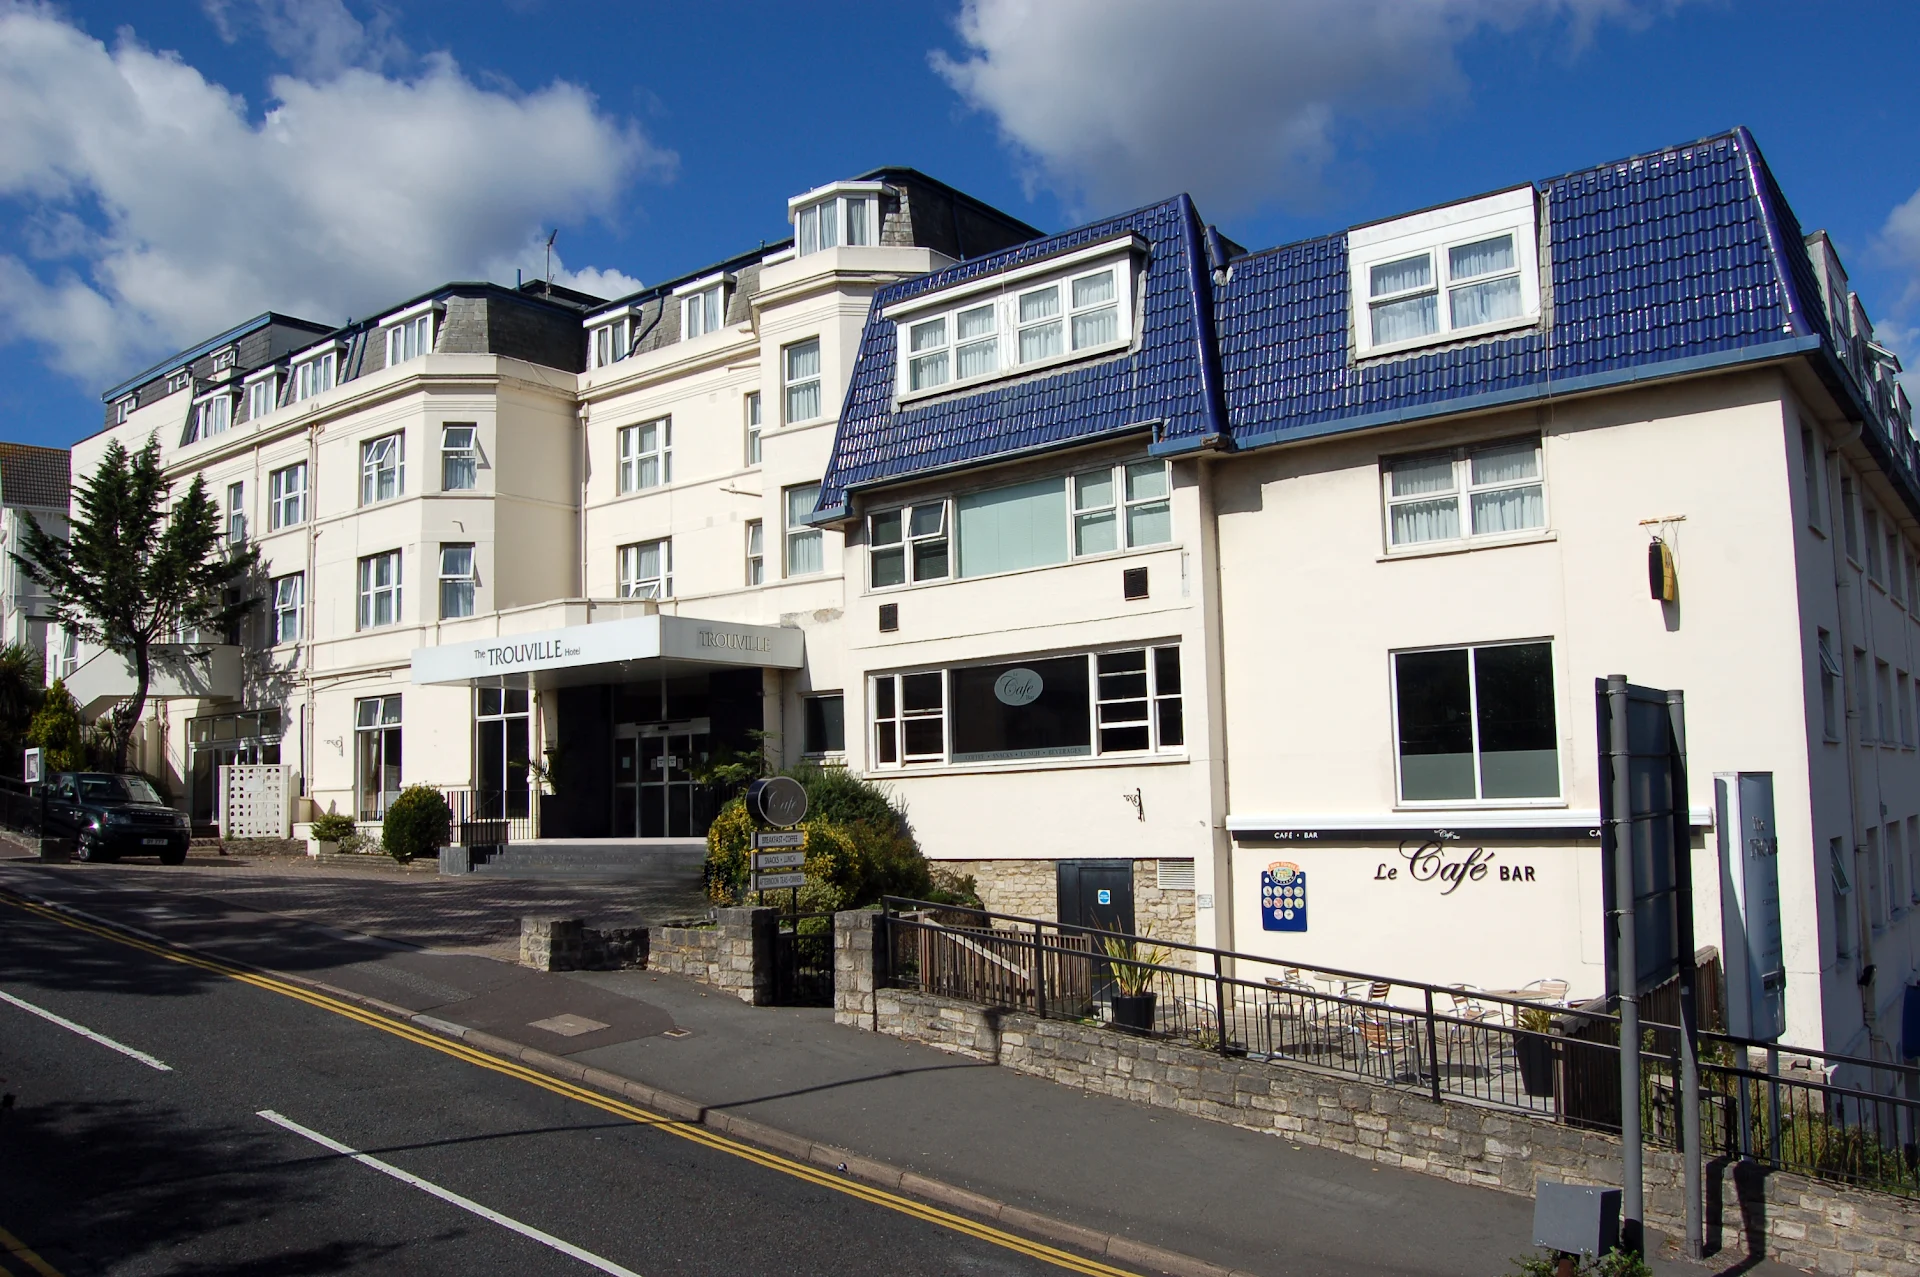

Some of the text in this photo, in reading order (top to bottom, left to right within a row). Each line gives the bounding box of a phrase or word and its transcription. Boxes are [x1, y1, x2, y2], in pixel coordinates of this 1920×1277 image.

[699, 630, 771, 652] TROUVILLE
[474, 639, 581, 666] The TROUVILLE Hotel
[1048, 748, 1082, 756] BEVERAGES
[761, 834, 798, 844] BREAKFAST COFFEE
[1304, 831, 1318, 839] BAR
[764, 855, 796, 864] SNACKS LUNCH
[1374, 840, 1536, 895] Le Café BAR
